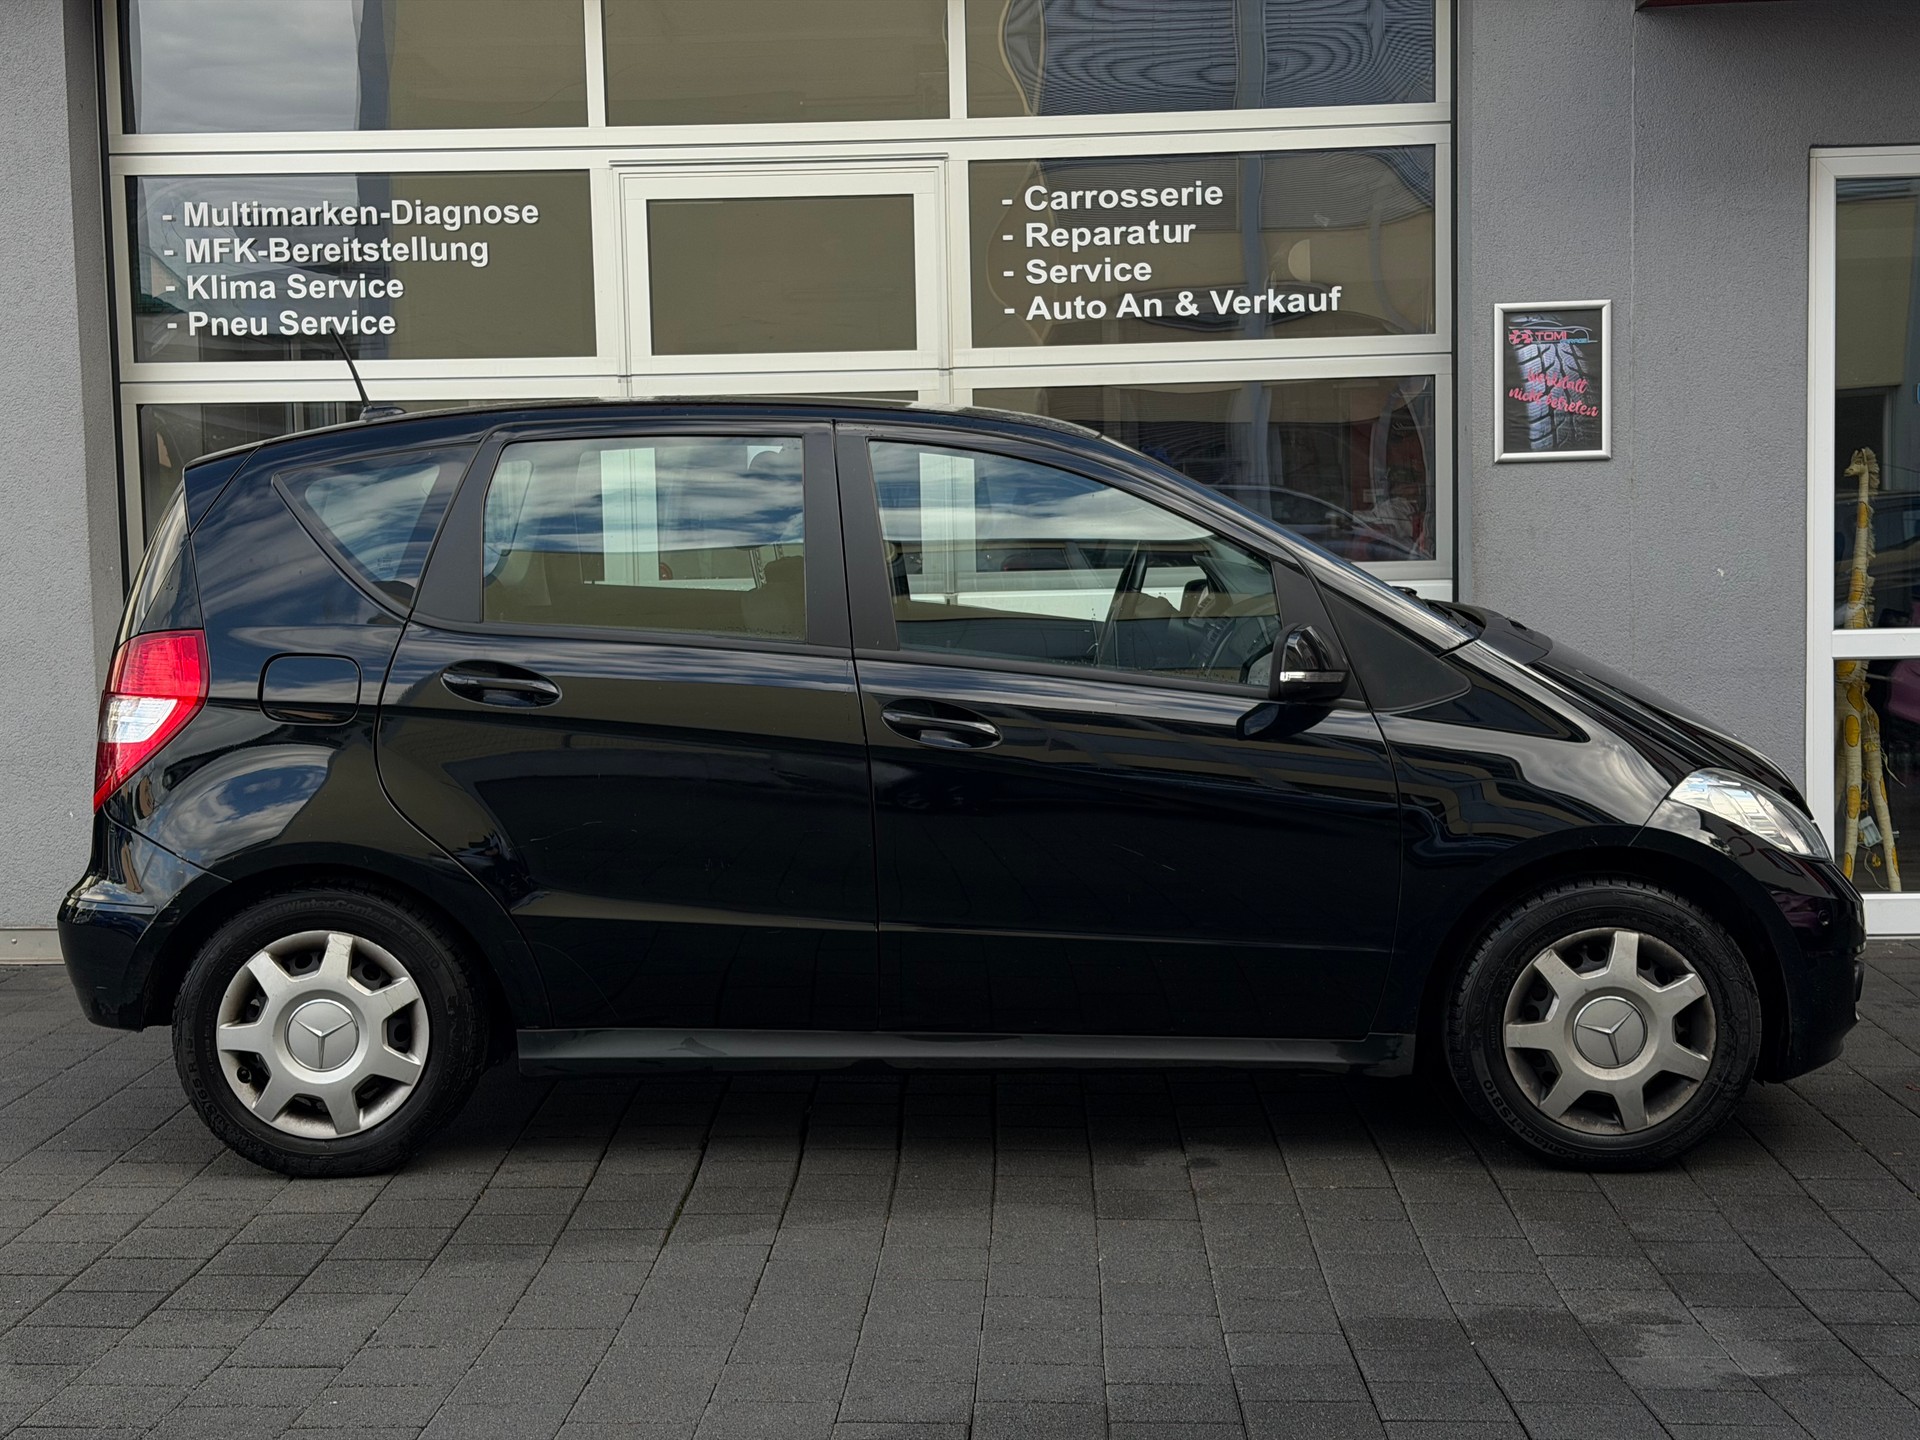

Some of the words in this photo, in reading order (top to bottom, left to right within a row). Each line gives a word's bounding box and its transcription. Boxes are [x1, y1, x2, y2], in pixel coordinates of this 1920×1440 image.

[1024, 180, 1223, 211] Carrosserie
[183, 199, 539, 231] Multimarken-Diagnose
[1025, 219, 1197, 253] Reparatur
[184, 236, 489, 268] MFK-Bereitstellung
[186, 274, 277, 300] Klima
[286, 273, 404, 299] Service
[1025, 257, 1153, 285] Service
[1025, 295, 1107, 321] Auto
[1115, 293, 1163, 318] An
[1174, 290, 1200, 317] &
[1209, 285, 1342, 315] Verkauf
[188, 311, 268, 337] Pneu
[279, 309, 396, 336] Service
[1535, 330, 1568, 341] TOMI
